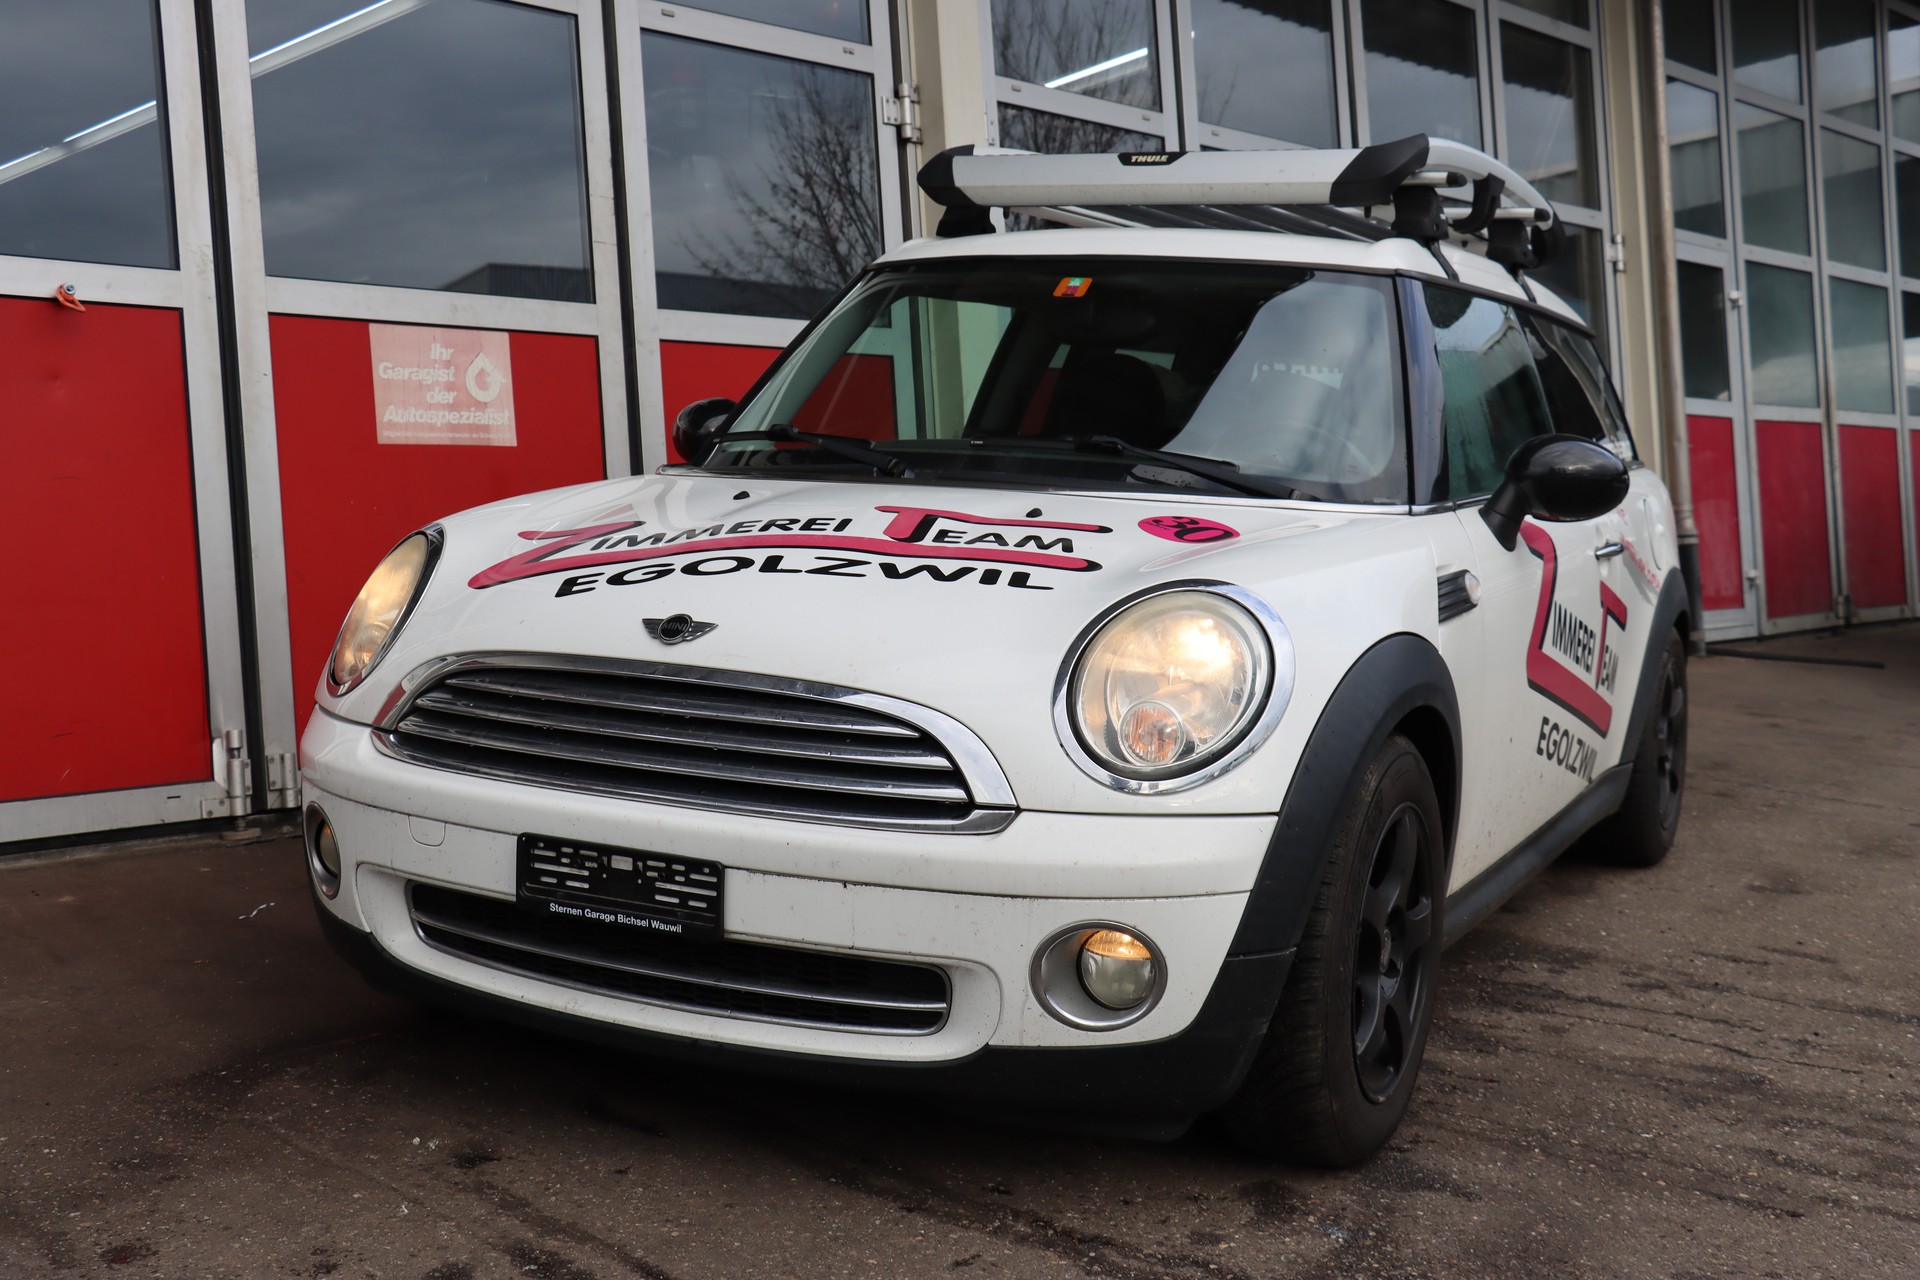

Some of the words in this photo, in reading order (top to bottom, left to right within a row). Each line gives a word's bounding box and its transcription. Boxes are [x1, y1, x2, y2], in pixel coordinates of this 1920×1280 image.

[1130, 154, 1169, 163] THULE
[430, 343, 454, 360] Ihr
[378, 361, 456, 384] Garagist
[426, 387, 457, 404] der
[383, 404, 510, 426] Autospezialist
[1151, 515, 1235, 543] 30
[467, 517, 854, 590] ZIMMEREI
[873, 505, 1113, 553] TEAM
[555, 554, 1054, 599] EGOLZWIL
[662, 621, 688, 632] MINI
[1536, 716, 1598, 783] EGOLZWIL
[549, 903, 583, 917] Sternen
[584, 908, 616, 923] Garage
[617, 913, 649, 928] Bichsel
[650, 919, 682, 933] Wauwil
